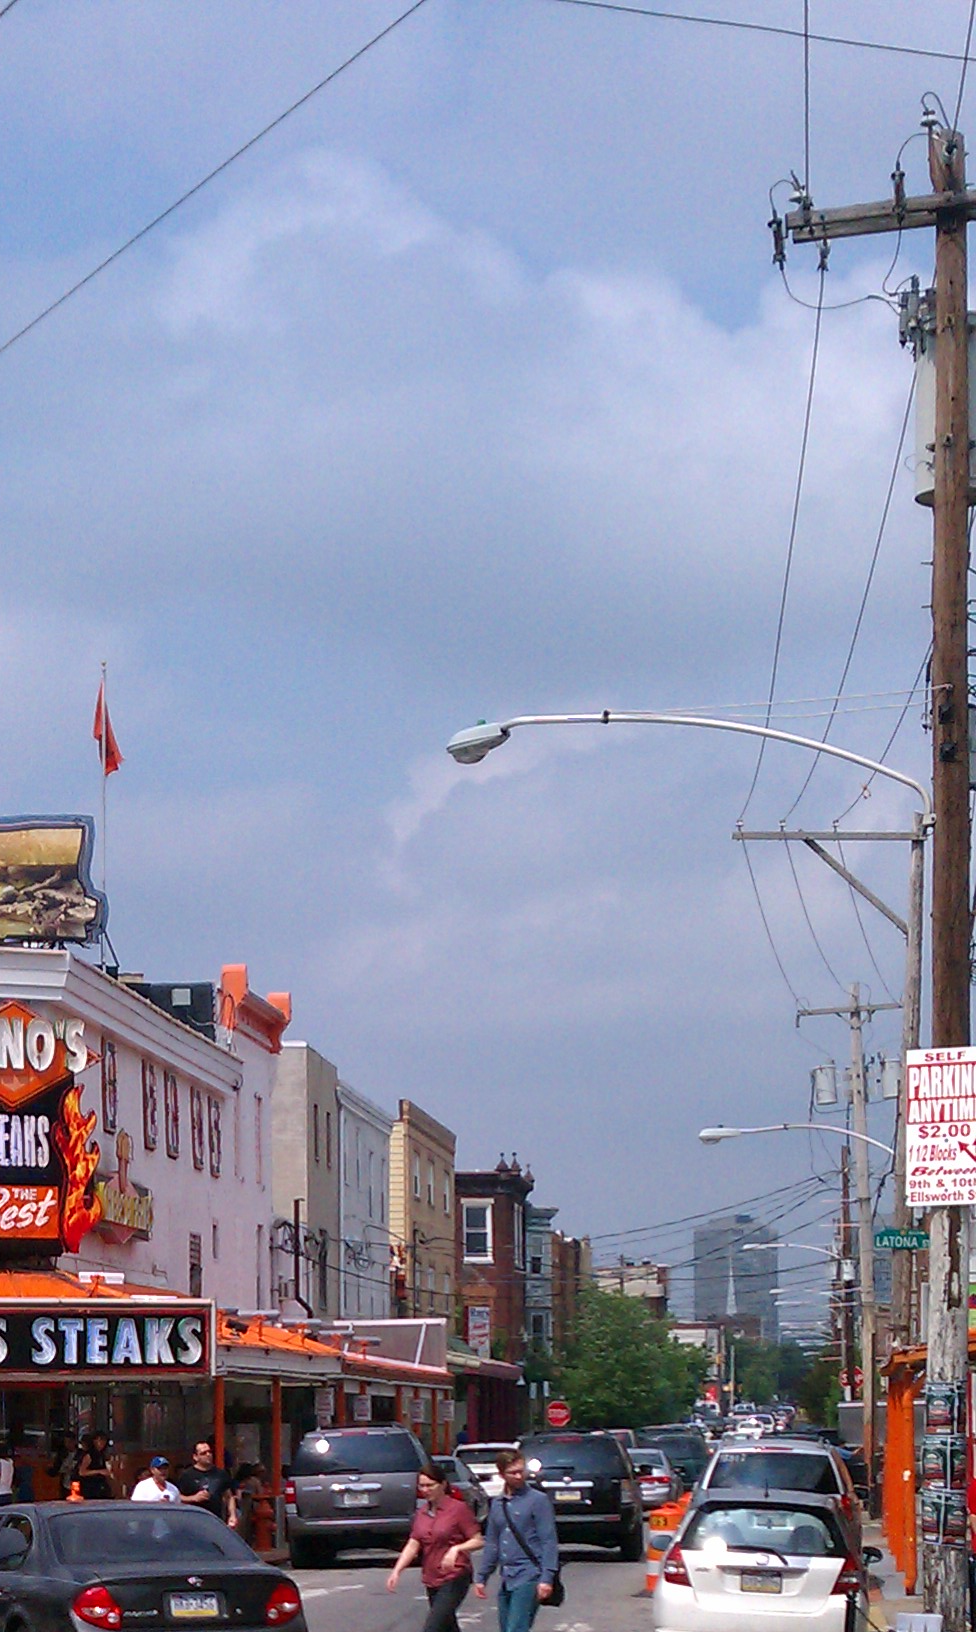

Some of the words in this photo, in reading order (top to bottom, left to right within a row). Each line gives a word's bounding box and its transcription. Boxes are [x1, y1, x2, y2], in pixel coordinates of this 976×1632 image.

[924, 1050, 966, 1062] SELF
[908, 1063, 976, 1100] PARKIN
[908, 1097, 976, 1123] ANYTIM
[918, 1124, 971, 1139] $2.00
[930, 1144, 957, 1162] Blocks
[909, 1179, 930, 1189] 9th
[936, 1178, 945, 1188] &
[12, 1187, 37, 1201] THE
[910, 1190, 964, 1202] Ellsworth
[968, 1188, 976, 1201] S
[876, 1235, 919, 1248] LATONA
[30, 1316, 203, 1365] STEAKS
